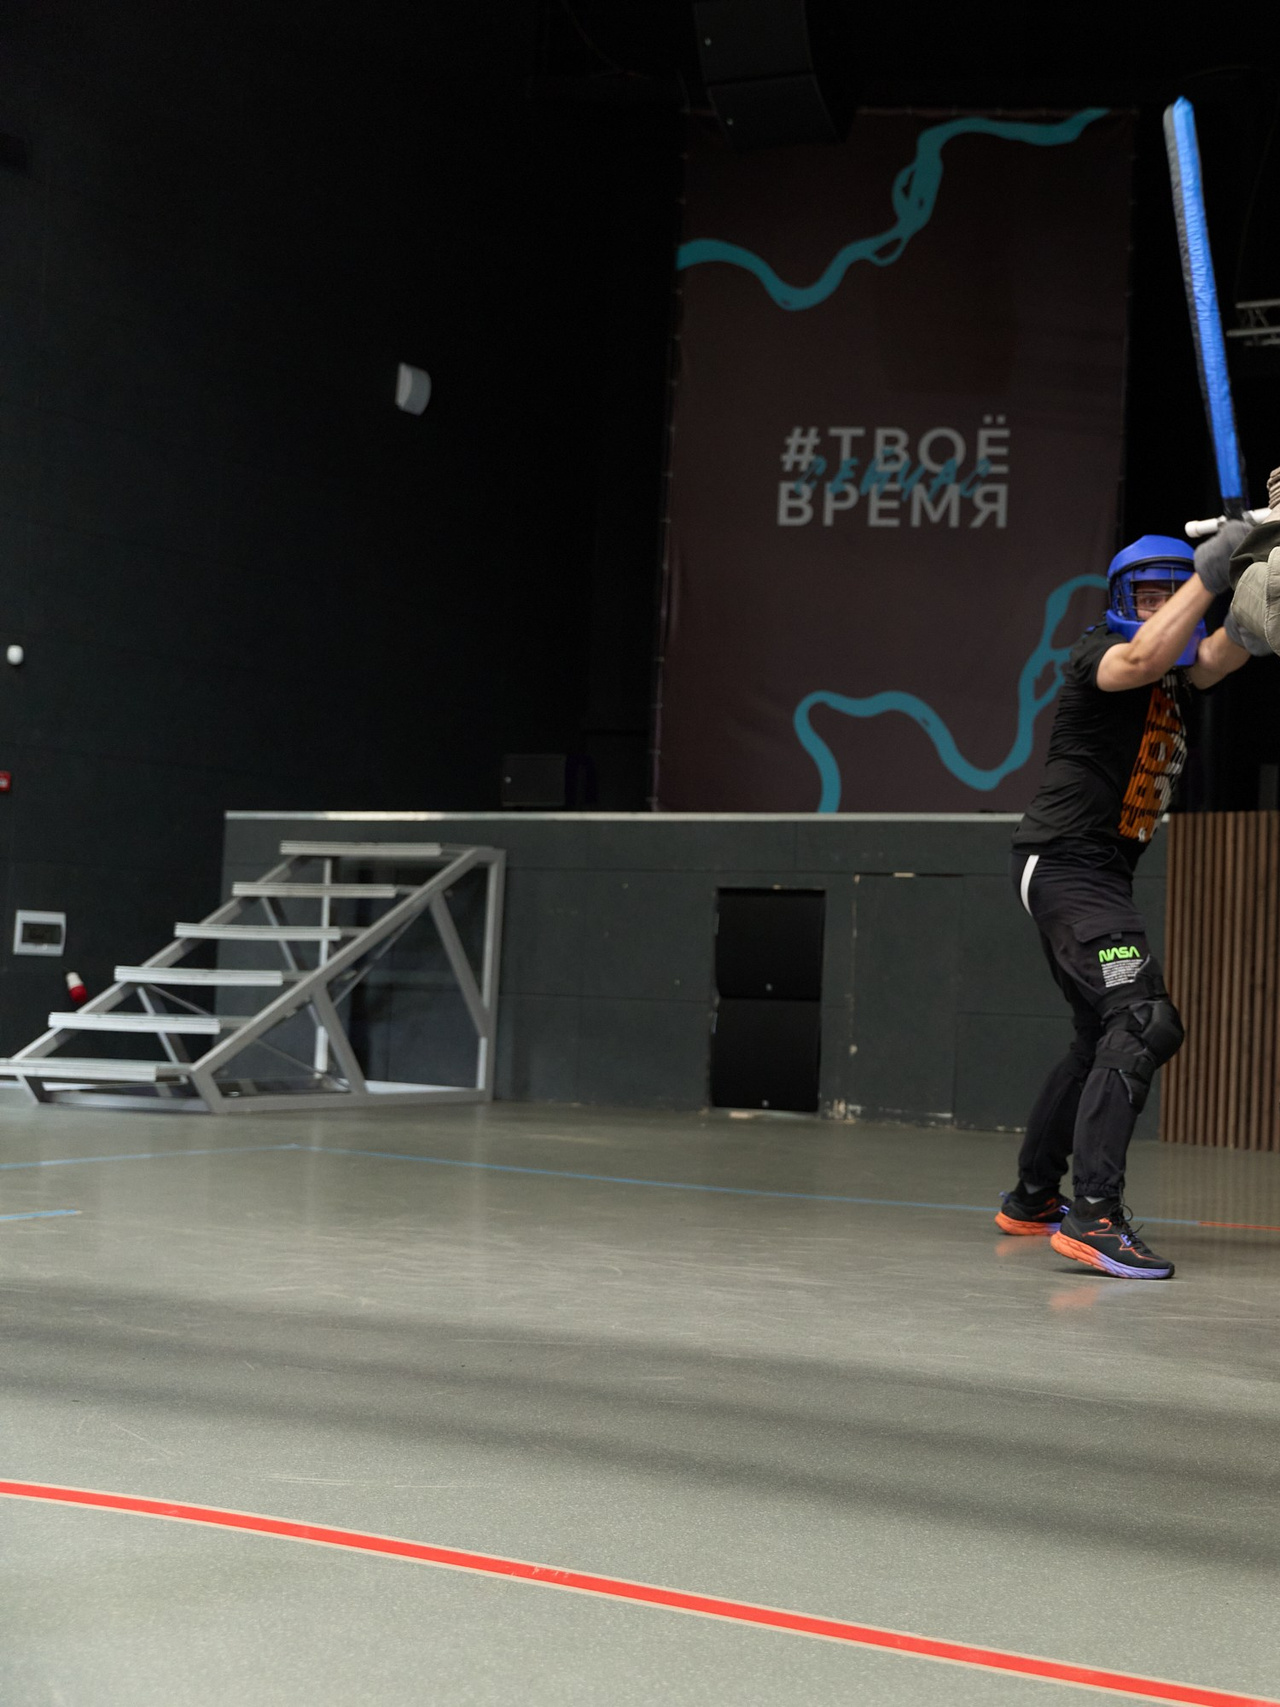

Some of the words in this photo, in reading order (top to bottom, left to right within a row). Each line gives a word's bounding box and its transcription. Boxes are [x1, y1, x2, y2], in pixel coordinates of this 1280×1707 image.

[780, 414, 1010, 474] #ТВОЁ
[777, 481, 1008, 528] ВРЕМЯ
[1098, 946, 1140, 963] NASA
